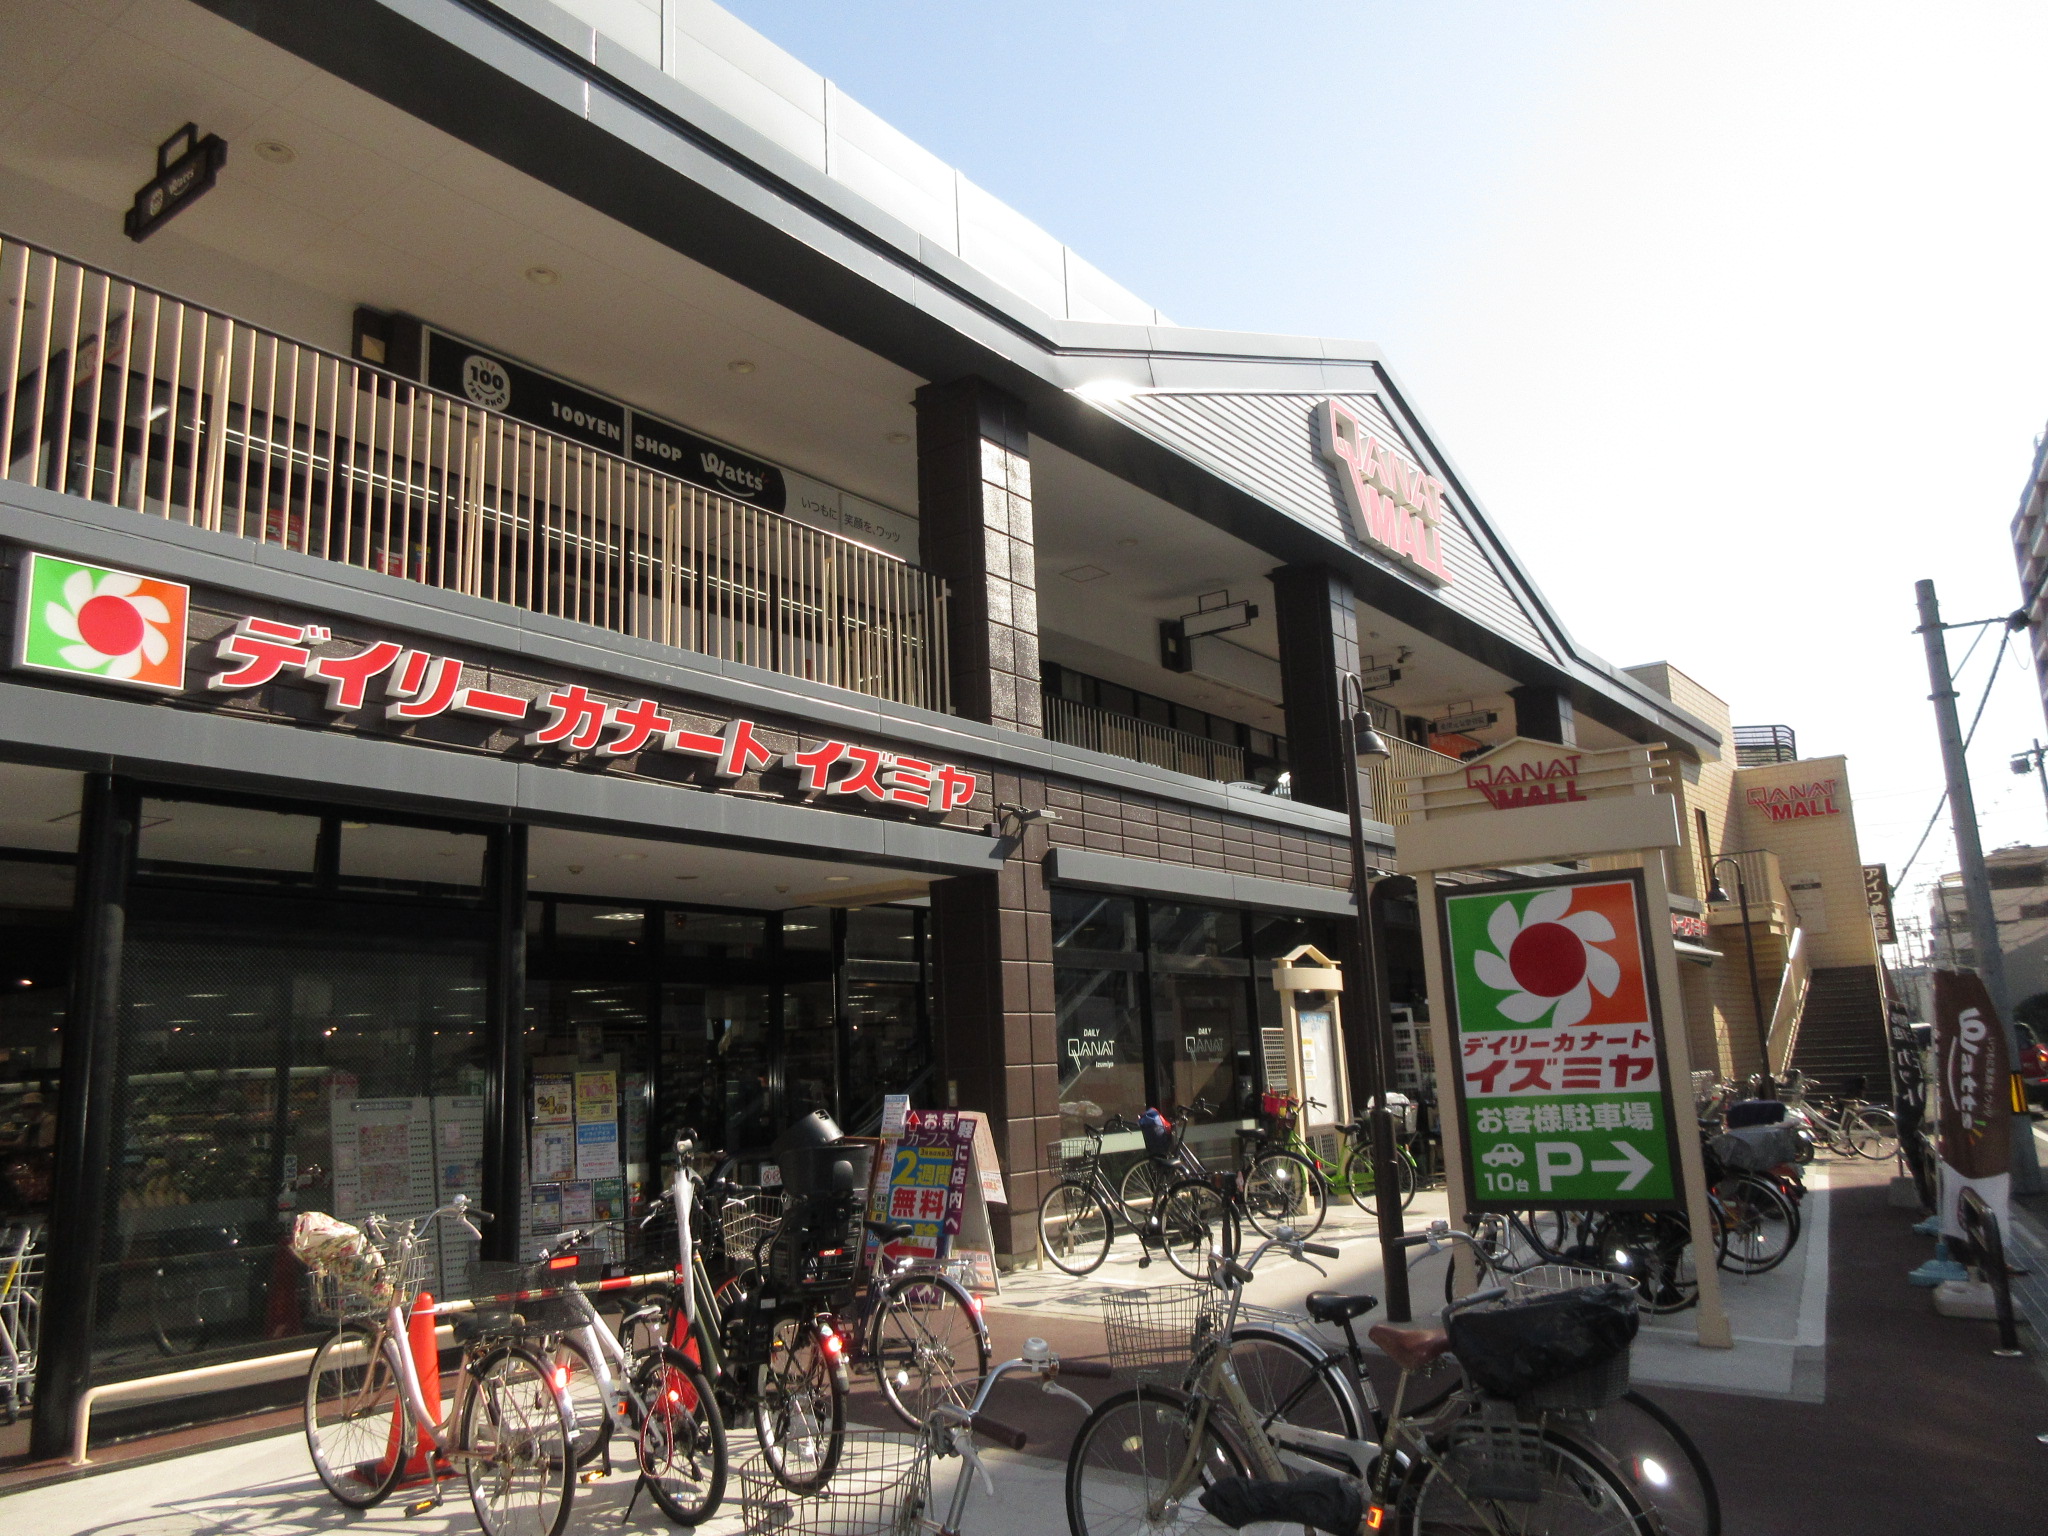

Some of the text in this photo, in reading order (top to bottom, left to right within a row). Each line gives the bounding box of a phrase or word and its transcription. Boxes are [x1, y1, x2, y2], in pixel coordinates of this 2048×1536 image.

[470, 365, 504, 391] 100
[467, 381, 507, 408] YEN SHOP
[551, 401, 763, 492] 100YEN SHOP Watts
[1364, 483, 1454, 584] MALL
[793, 738, 978, 813] イズミヤ
[1494, 780, 1588, 810] MALL
[1771, 798, 1840, 822] MALL
[1083, 1028, 1100, 1037] DAILY
[1463, 1028, 1651, 1057] デイリーカナート
[1465, 1053, 1655, 1094] イズミヤ
[1957, 1007, 1987, 1130] Watts
[1476, 1101, 1655, 1134] お客様駐車場
[1534, 1141, 1584, 1193] P
[891, 1189, 945, 1220] 無料
